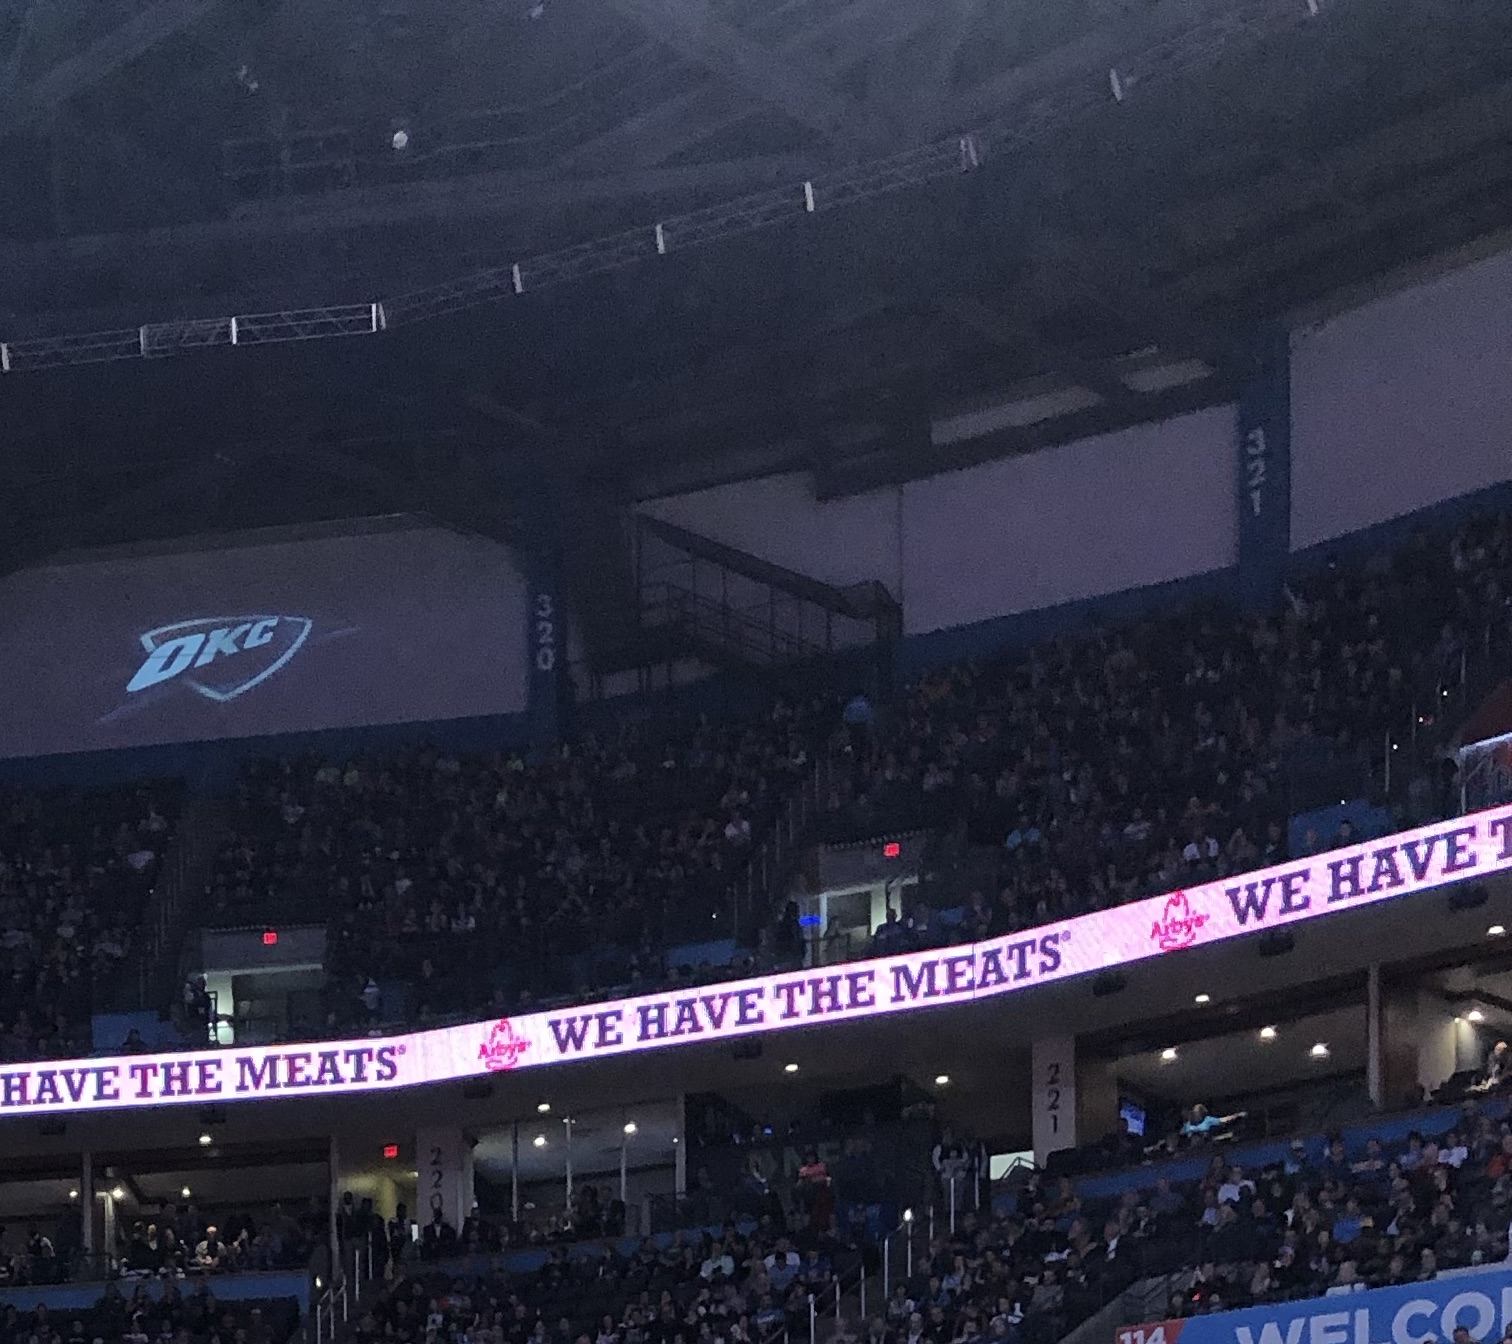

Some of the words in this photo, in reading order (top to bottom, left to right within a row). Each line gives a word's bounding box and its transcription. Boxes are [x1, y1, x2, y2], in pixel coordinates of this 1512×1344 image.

[1225, 868, 1311, 925] WE
[1327, 826, 1477, 904] HAVE
[548, 1009, 624, 1054] WE
[636, 987, 764, 1042] HAVE
[774, 969, 876, 1020] THE
[0, 1065, 120, 1107] HAVE
[130, 1058, 223, 1098] THE
[1046, 1062, 1061, 1135] 221
